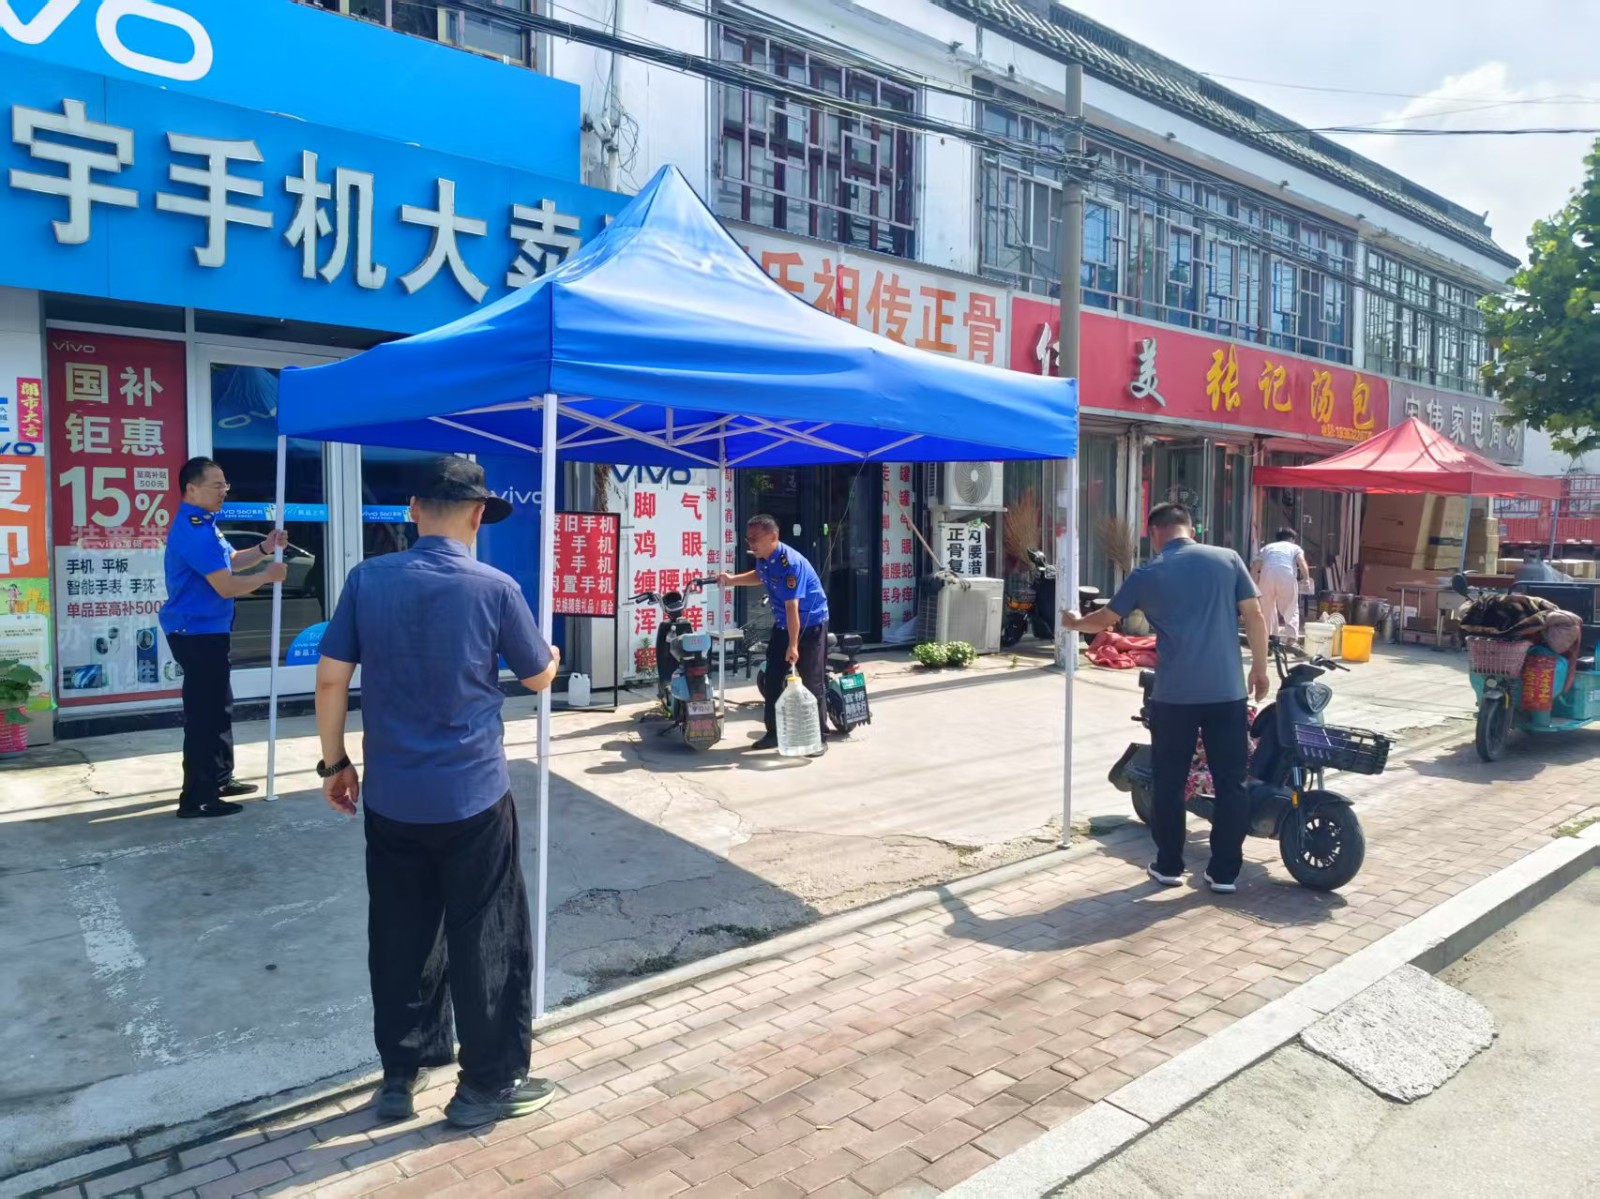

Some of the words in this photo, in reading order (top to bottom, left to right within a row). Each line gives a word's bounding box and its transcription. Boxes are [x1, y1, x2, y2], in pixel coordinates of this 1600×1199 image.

[9, 98, 618, 303] 宇手机大卖
[53, 341, 96, 354] vivo
[65, 361, 164, 407] 国补
[1206, 343, 1376, 431] 张记汤包
[65, 411, 165, 456] 钜惠
[60, 466, 170, 528] 15%
[140, 480, 164, 488] 500元
[634, 491, 702, 521] 脚气
[634, 530, 702, 558] 鸡眼
[66, 559, 94, 574] 手机
[102, 558, 128, 574] 平板
[67, 579, 122, 595] 智能手表
[130, 578, 156, 593] 手环
[634, 568, 703, 594] 缠腰蛇
[67, 600, 166, 618] 单品至高补500
[634, 605, 702, 635] 浑痒
